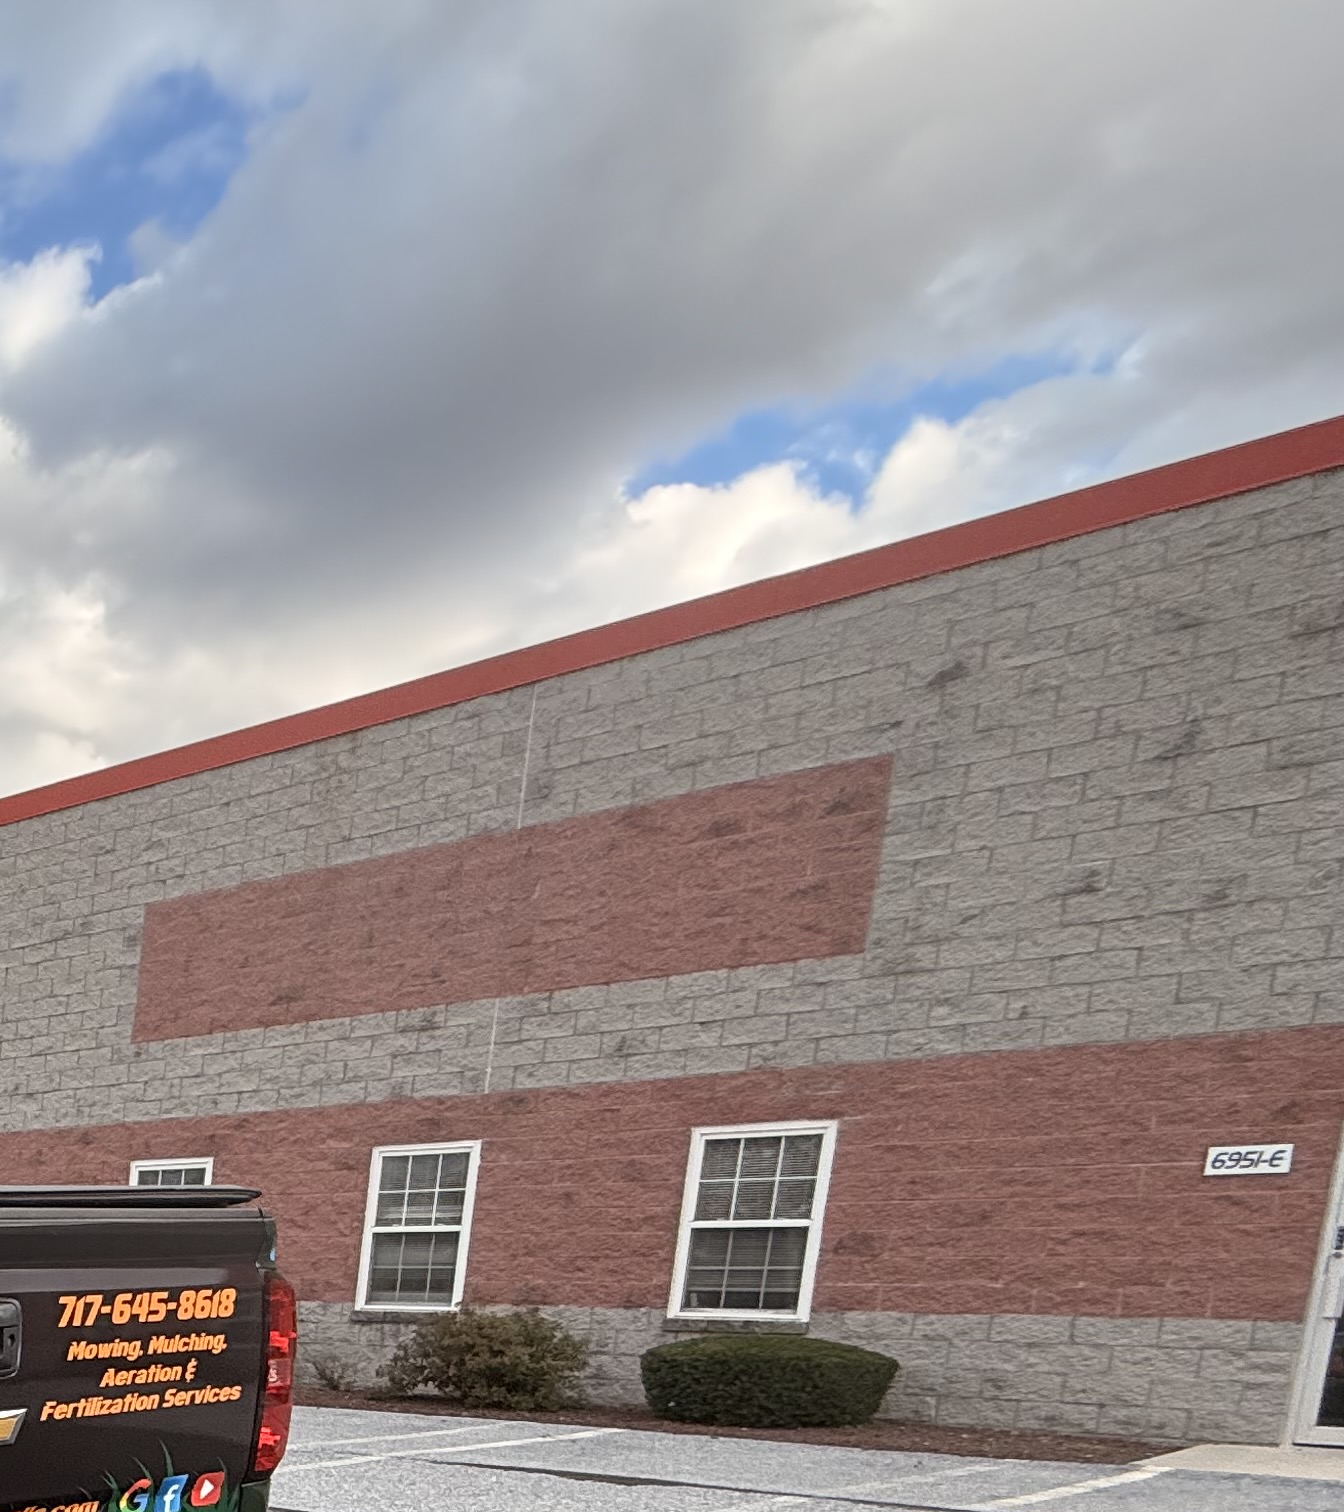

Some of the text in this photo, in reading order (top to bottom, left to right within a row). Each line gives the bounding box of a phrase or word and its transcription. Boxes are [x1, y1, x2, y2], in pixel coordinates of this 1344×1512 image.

[1211, 1149, 1288, 1170] 6951-E
[57, 1287, 238, 1329] 717-645-8618
[98, 1357, 198, 1388] Aeration &
[39, 1384, 243, 1422] Fertilization Services
